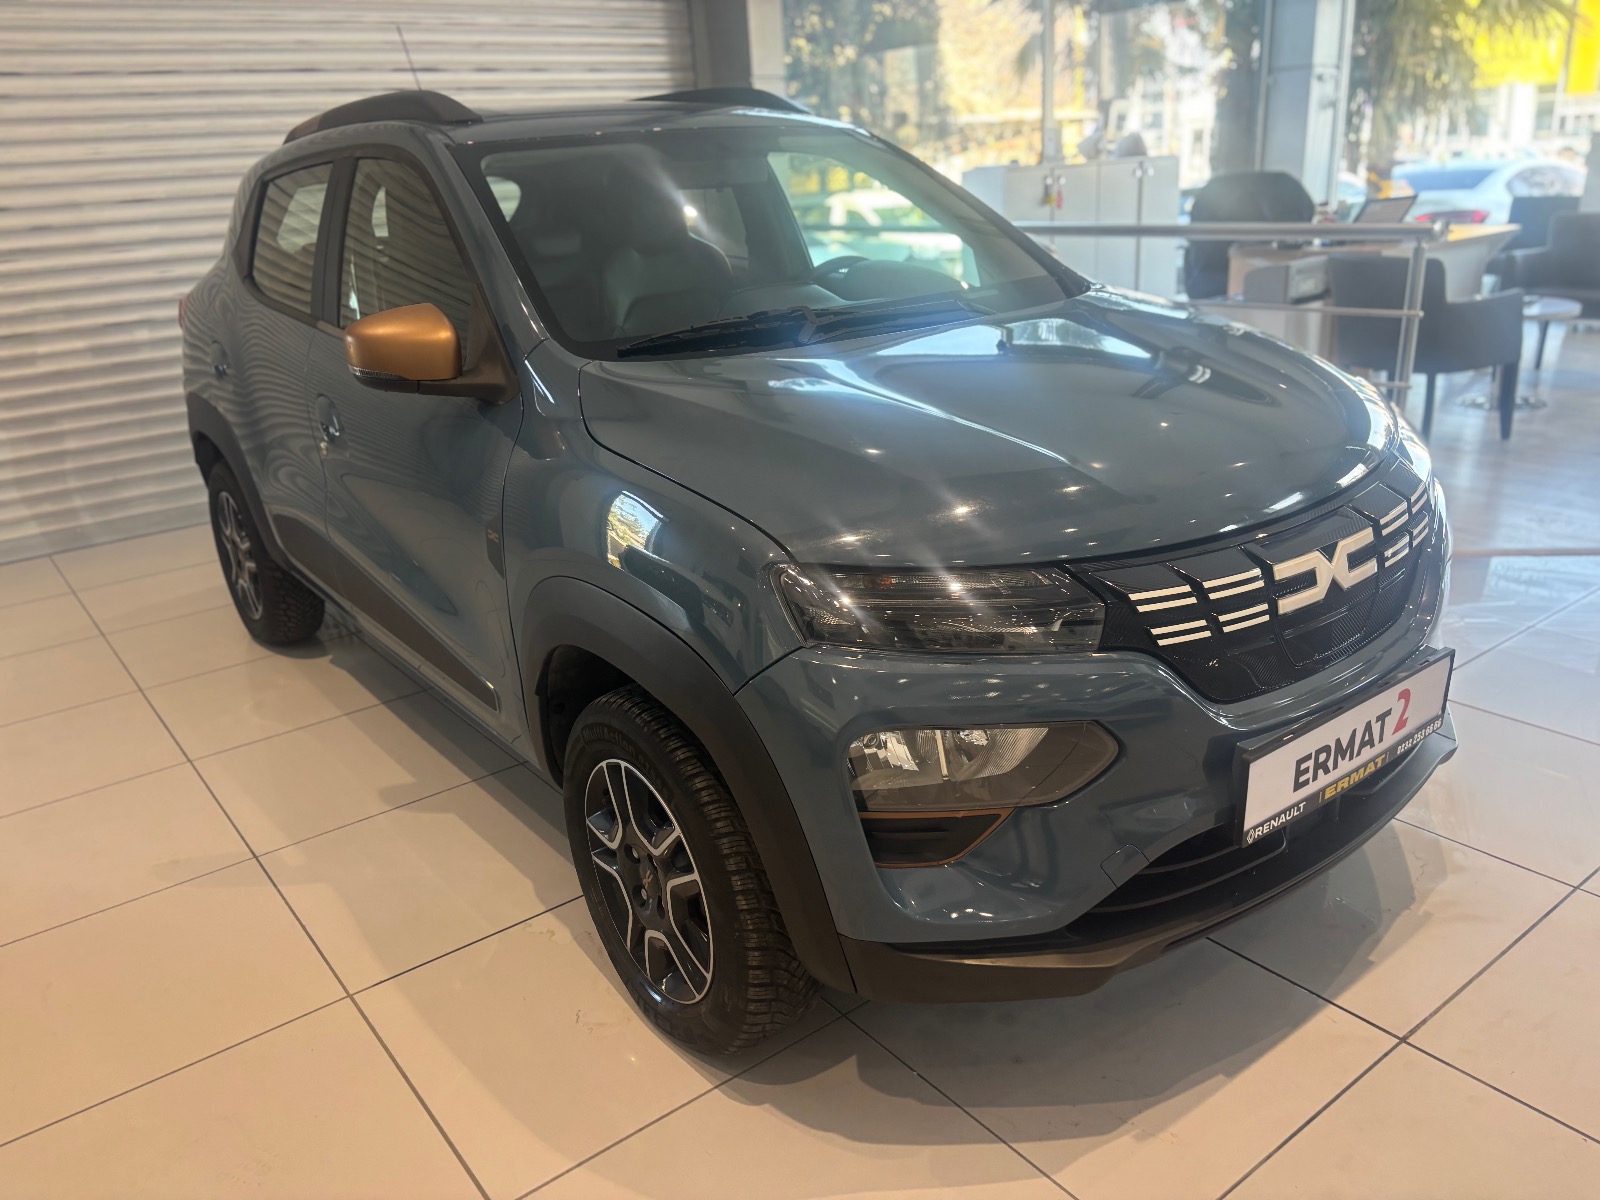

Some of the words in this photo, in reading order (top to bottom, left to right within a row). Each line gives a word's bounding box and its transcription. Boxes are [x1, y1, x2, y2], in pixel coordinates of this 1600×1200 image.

[1293, 707, 1392, 793] ERMAT
[1392, 688, 1411, 736] 2
[1254, 802, 1306, 837] RENAULT
[1324, 754, 1386, 800] ERMAT
